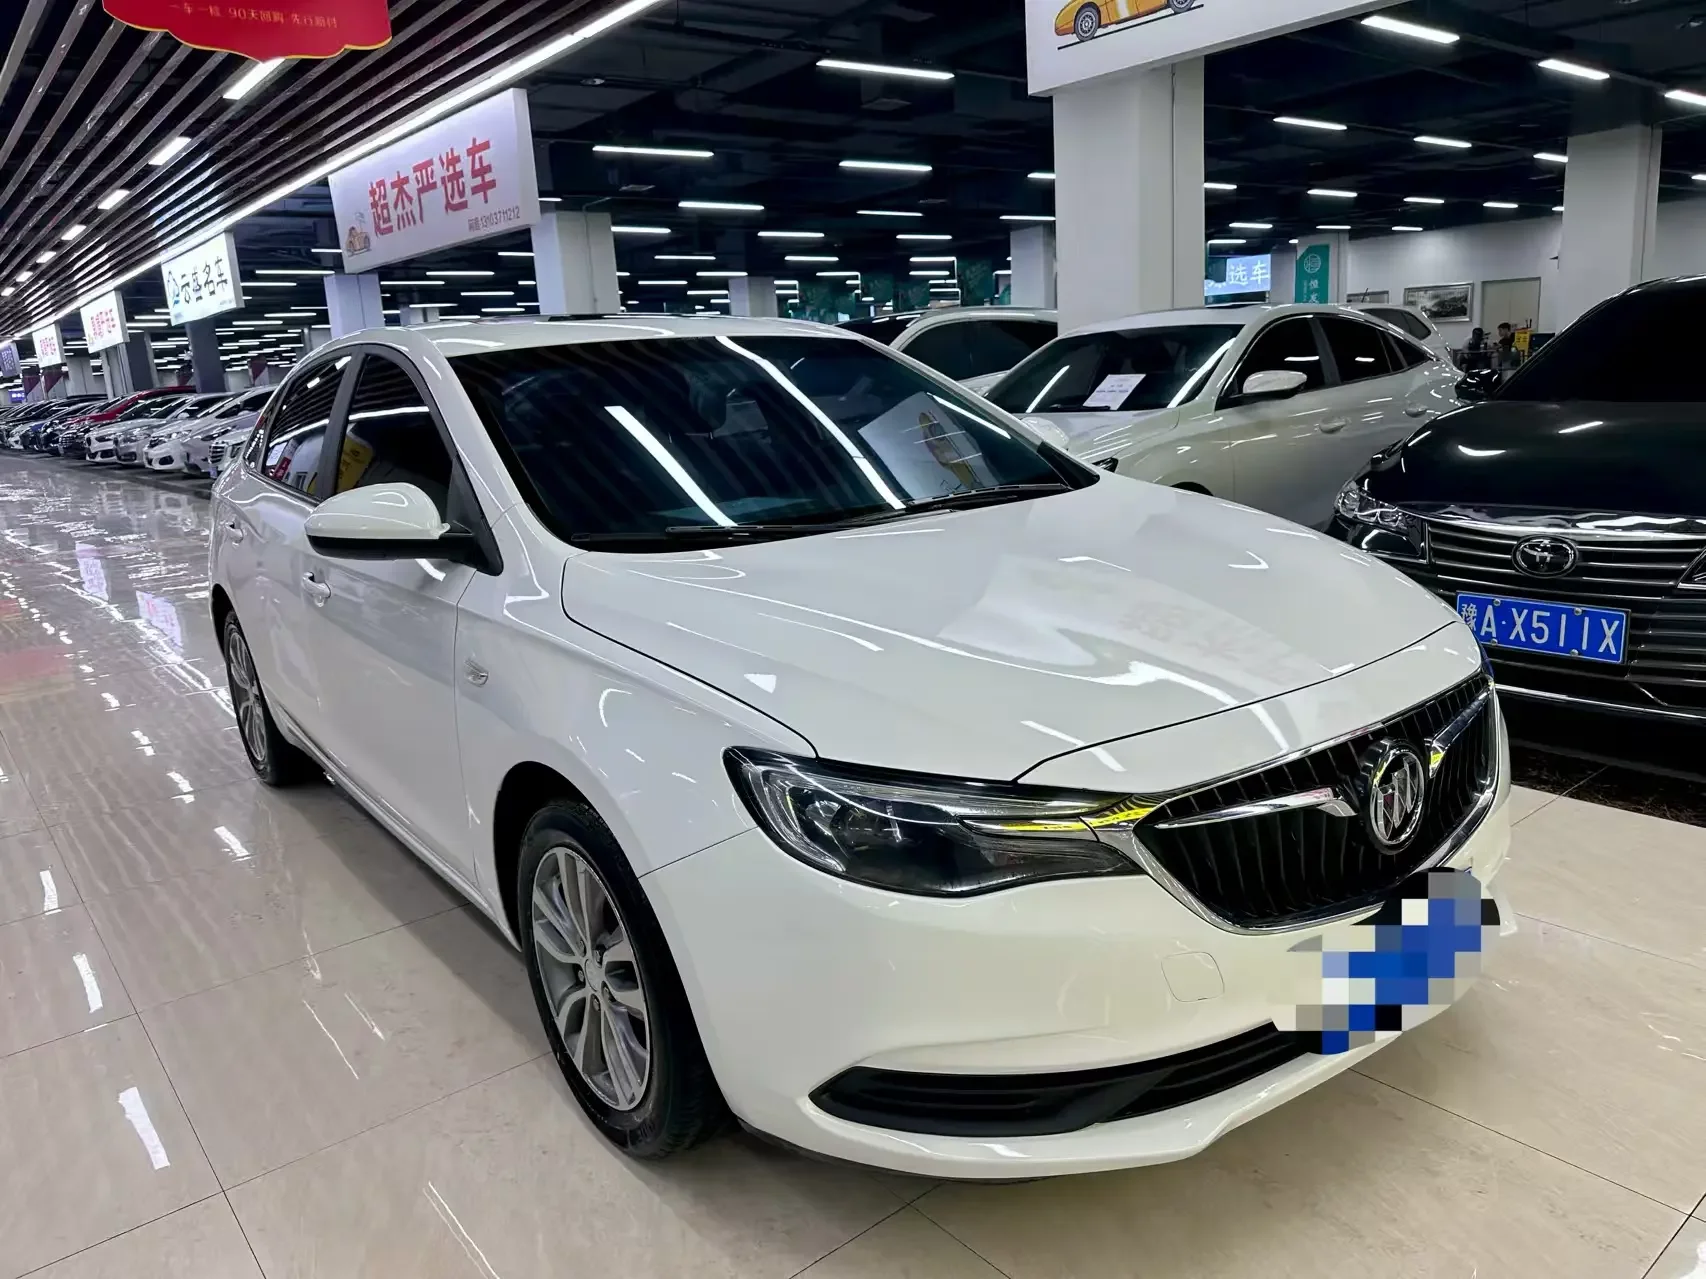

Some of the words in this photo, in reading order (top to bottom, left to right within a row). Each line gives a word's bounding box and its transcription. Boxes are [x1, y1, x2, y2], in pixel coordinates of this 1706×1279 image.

[228, 7, 284, 24] 90天回购
[368, 136, 497, 237] 超杰严选车
[1228, 260, 1269, 285] 选车
